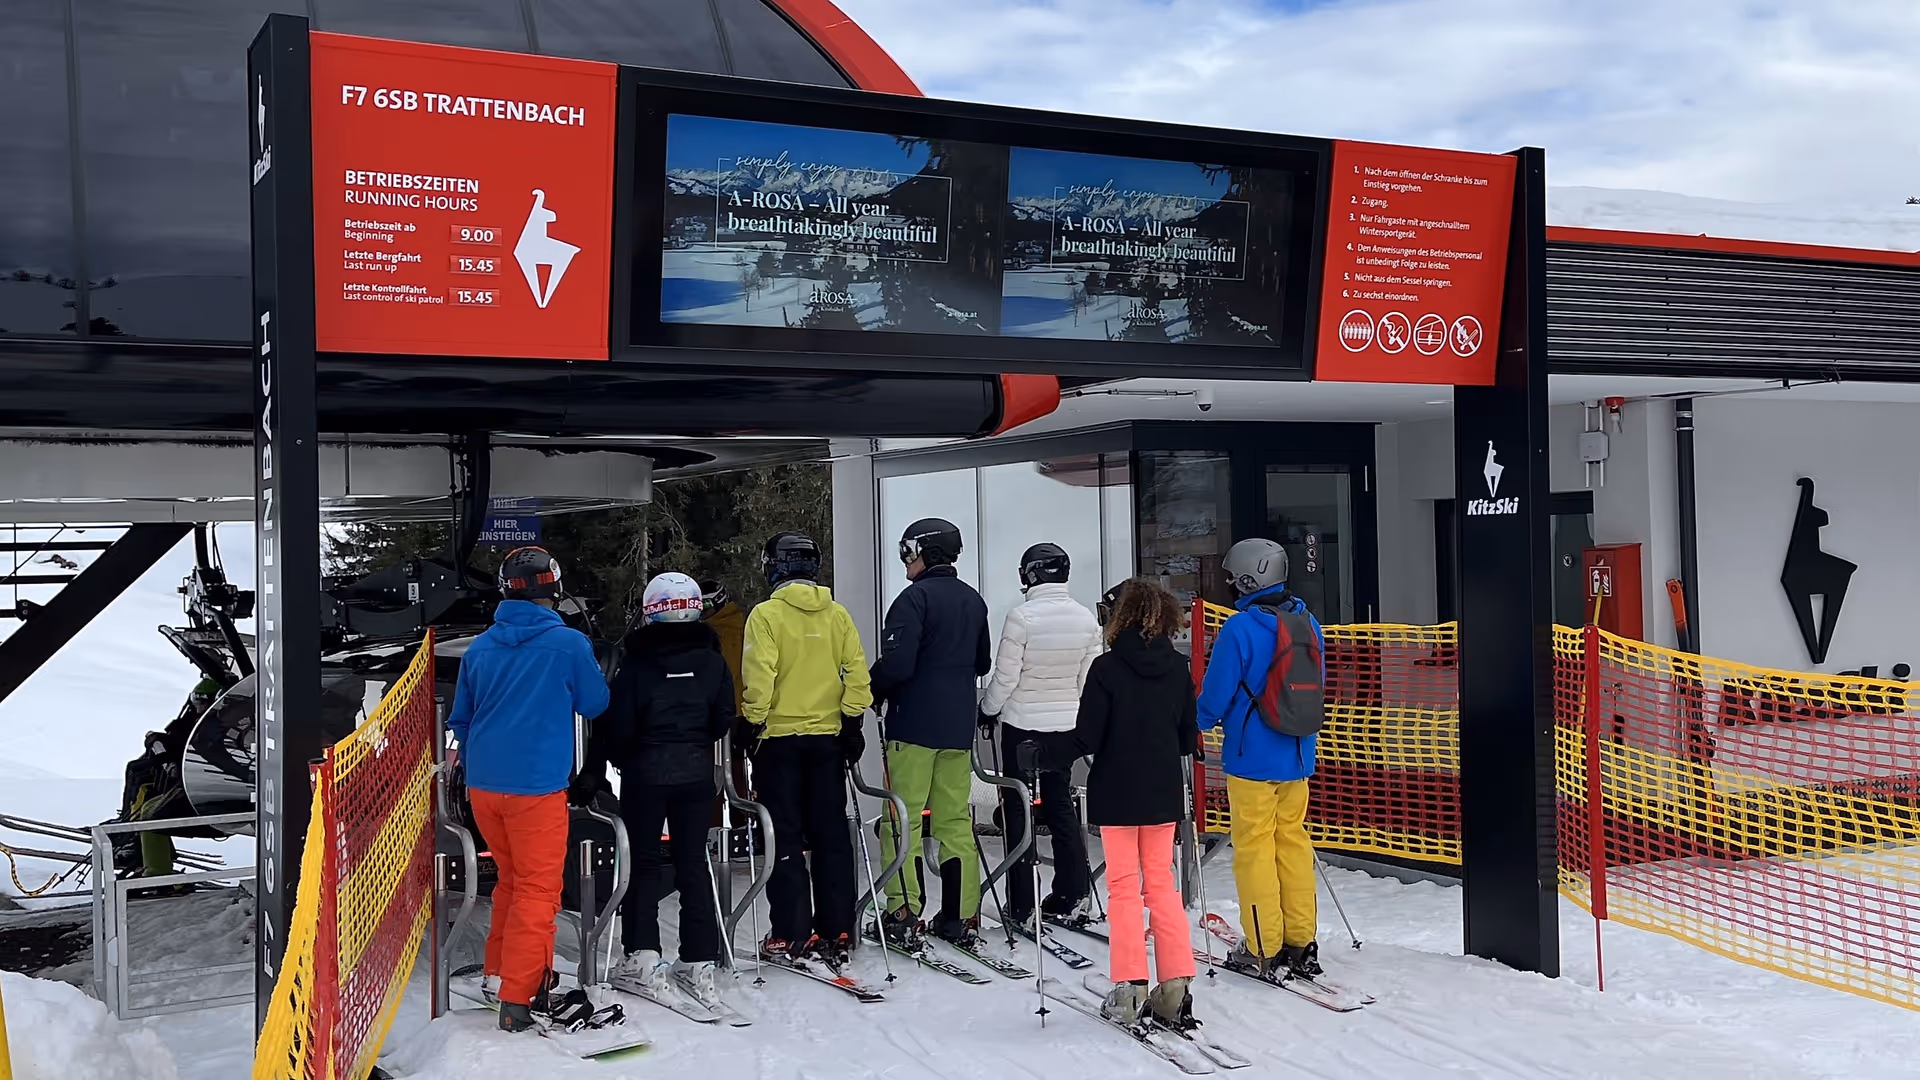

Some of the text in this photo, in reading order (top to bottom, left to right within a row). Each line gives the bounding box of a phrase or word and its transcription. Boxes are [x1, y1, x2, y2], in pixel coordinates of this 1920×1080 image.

[342, 85, 585, 126] F7 6SB TRATTENBACH
[736, 150, 842, 183] simply enjoy
[345, 170, 479, 193] BETRIEBSZEITEN
[1354, 165, 1359, 174] 1.
[1364, 167, 1382, 176] Nach
[1382, 169, 1398, 177] dem
[1421, 172, 1433, 180] der
[1433, 173, 1462, 183] Schranke
[1463, 176, 1473, 185] bis
[1069, 178, 1159, 207] simply enjoy
[1363, 179, 1423, 193] Einstieg vorgehen.
[345, 190, 478, 212] RUNNING HOURS
[728, 190, 804, 211] A-ROSA
[823, 196, 848, 214] All
[851, 202, 890, 218] year
[1351, 195, 1389, 209] 2. Zugang.
[344, 219, 416, 232] Betriebszeit ab
[728, 212, 937, 243] breathtakingly beautiful
[1062, 216, 1125, 234] A-ROSA
[1141, 220, 1162, 237] All
[1165, 226, 1197, 240] year
[1349, 212, 1356, 221] 3.
[1360, 213, 1373, 222] Nur
[1406, 218, 1418, 226] mit
[1419, 220, 1470, 230] angeschnalltem
[344, 229, 394, 243] Beginning
[460, 228, 494, 242] 9.00
[344, 250, 421, 263] Letzte Bergfahrt
[1061, 235, 1236, 263] breathtakingly beautiful
[1346, 243, 1483, 260] 4. Den Anweisungen des Betriebspersonal
[344, 261, 397, 274] Last run up
[458, 258, 494, 272] 15.45
[1356, 256, 1450, 270] ist unbedingt Folge zu leisten.
[343, 282, 427, 294] Letzte Kontrollfahrt
[1343, 272, 1350, 280] 5.
[1354, 273, 1373, 282] Nicht
[1386, 275, 1401, 284] dem
[1402, 276, 1422, 285] Sessel
[1423, 278, 1452, 288] springen.
[343, 291, 444, 305] Last control of ski patrol
[457, 291, 493, 304] 15.45
[1342, 289, 1419, 301] 6. Zu sechst einordnen.
[1467, 497, 1519, 515] KitzSki
[493, 519, 517, 529] HIER
[260, 311, 276, 968] F7 6SB TRATTENBACH
